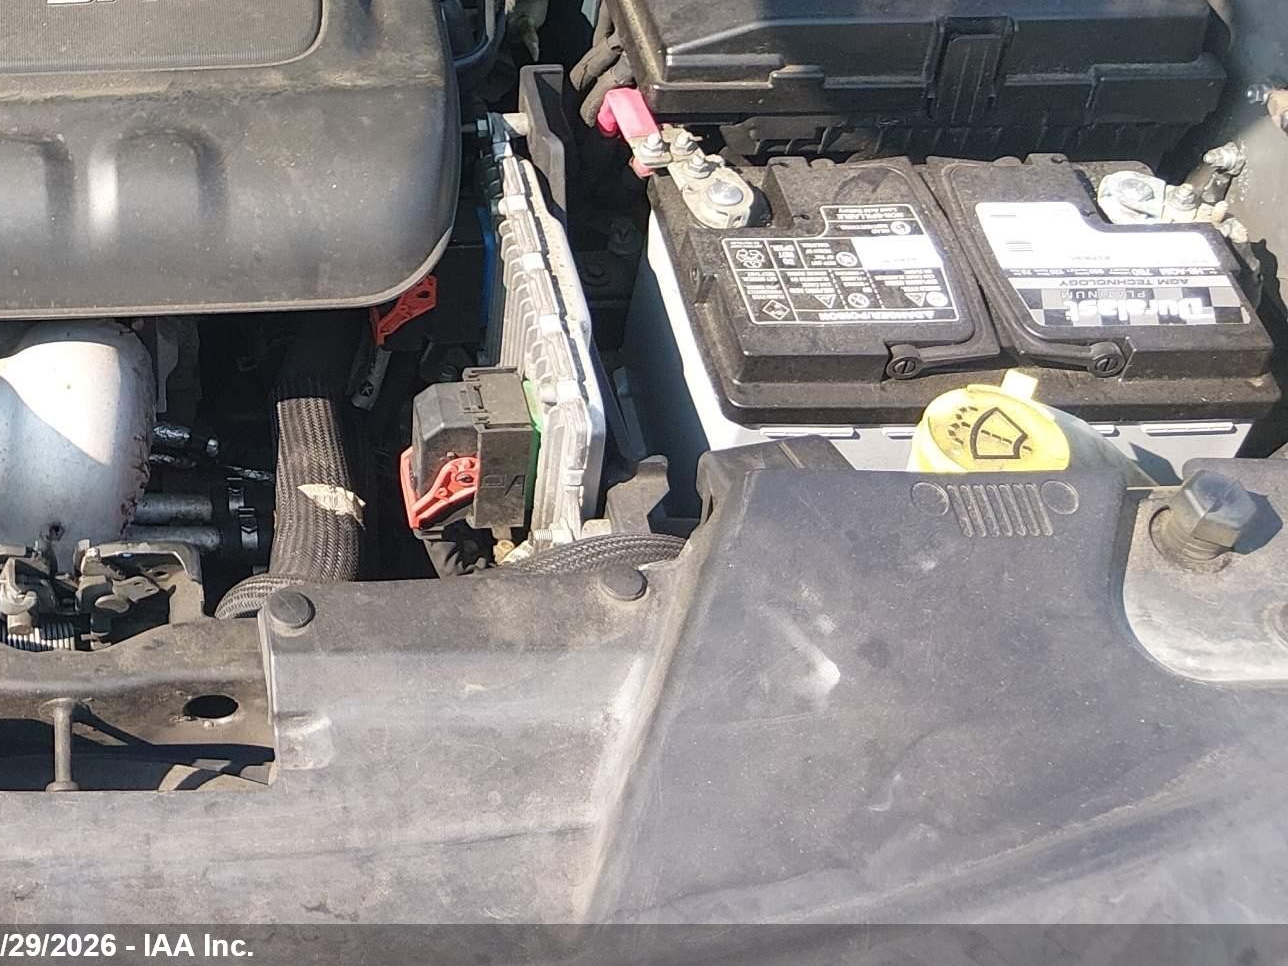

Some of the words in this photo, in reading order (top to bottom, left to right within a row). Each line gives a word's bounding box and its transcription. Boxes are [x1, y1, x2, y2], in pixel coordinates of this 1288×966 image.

[1059, 277, 1153, 287] TECHNOLOGY
[1157, 277, 1189, 286] AGM
[1059, 290, 1146, 299] PLATINUM
